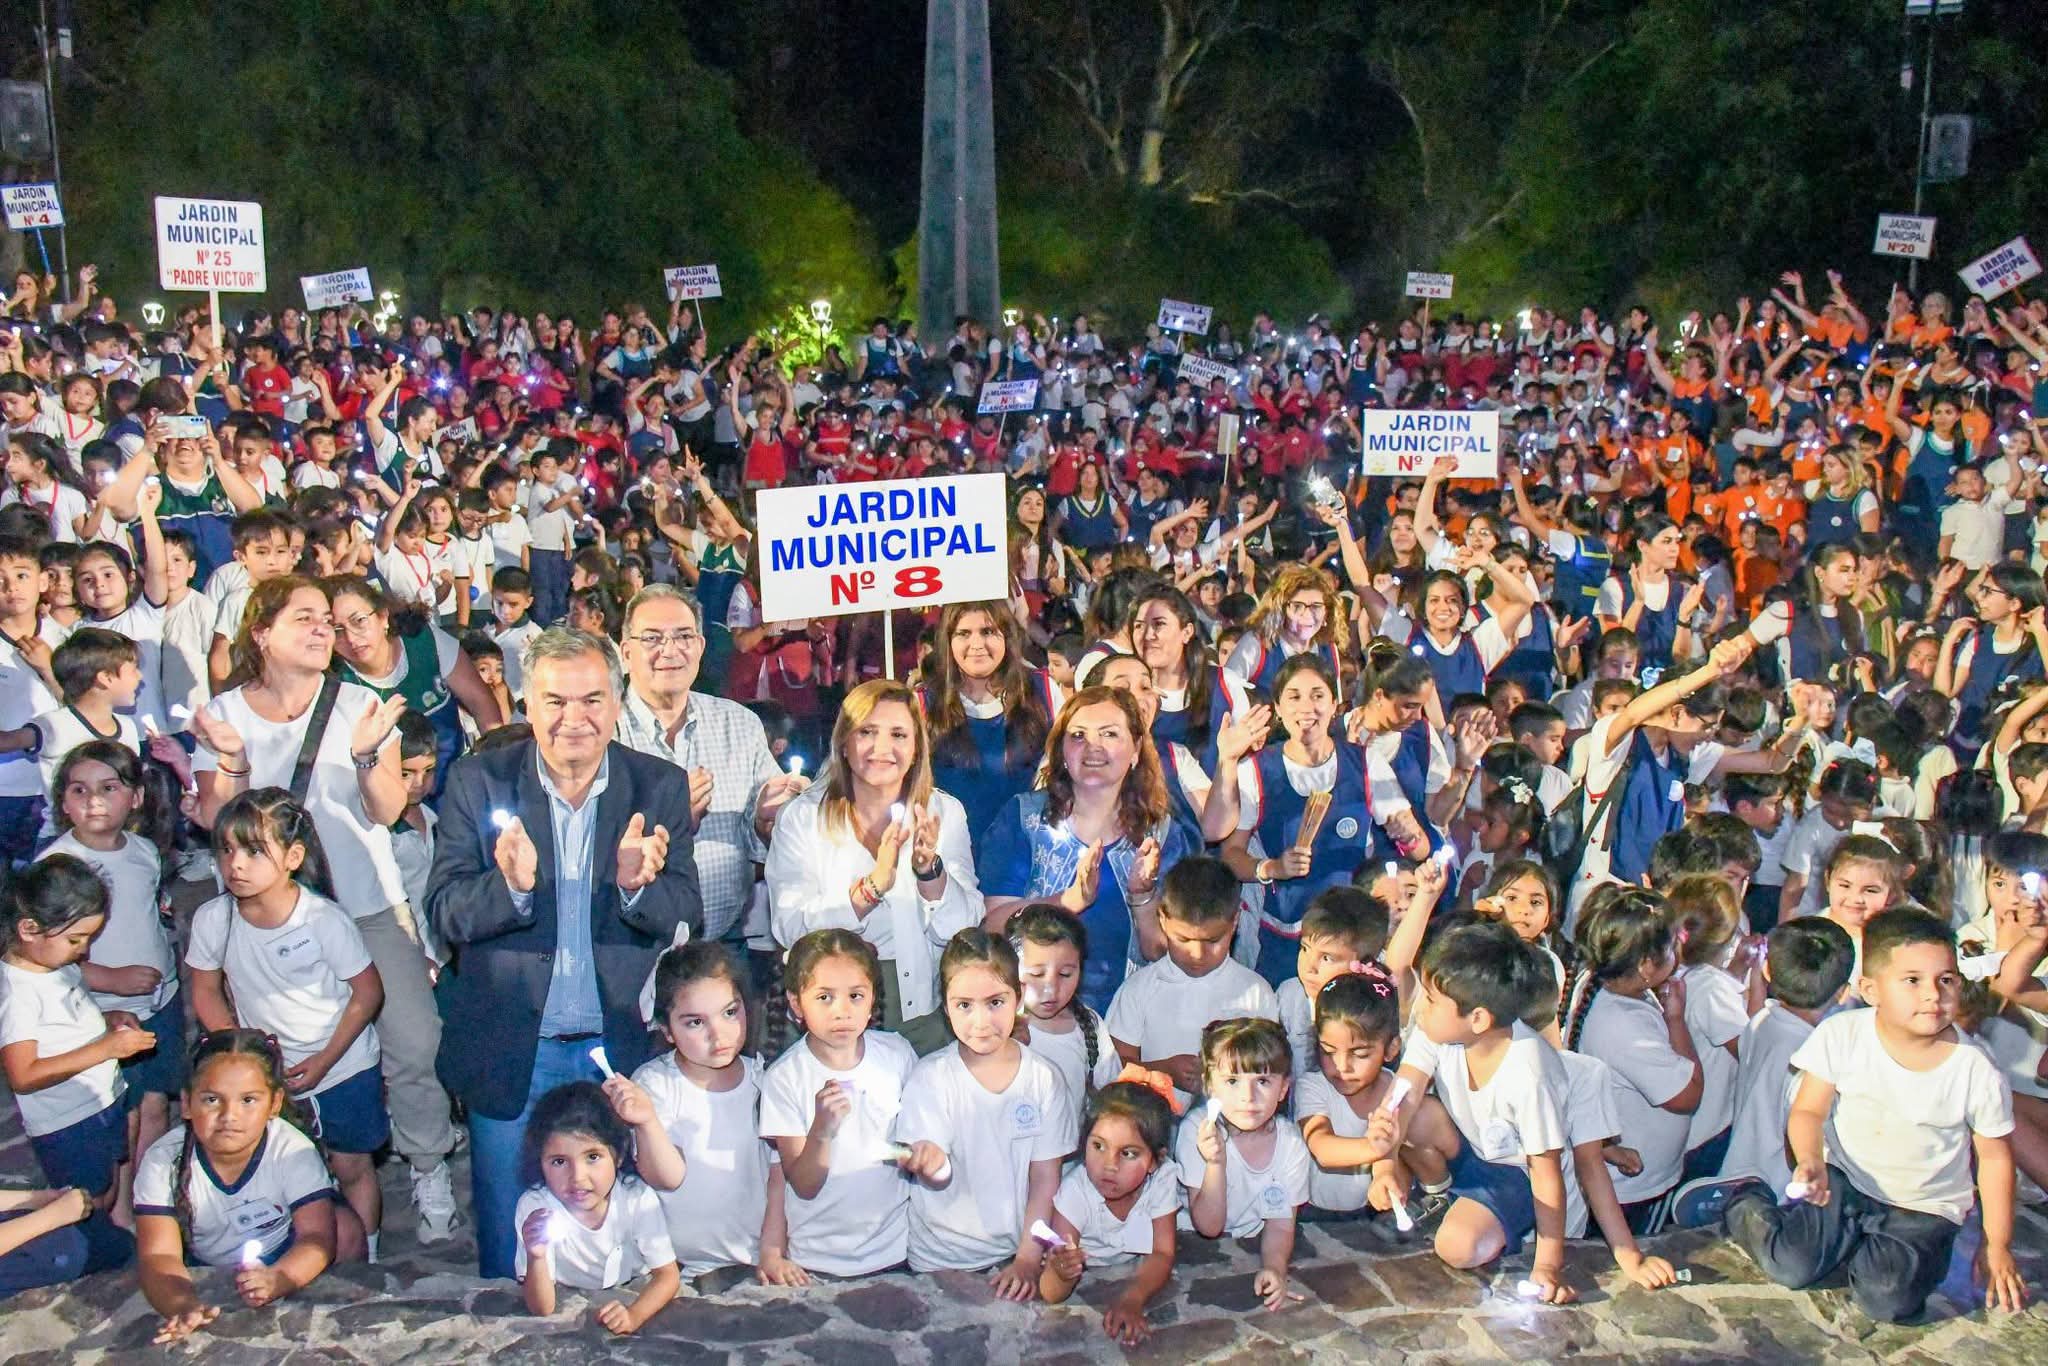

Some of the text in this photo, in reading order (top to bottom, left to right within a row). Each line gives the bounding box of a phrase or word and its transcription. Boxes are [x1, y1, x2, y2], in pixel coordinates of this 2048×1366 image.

[13, 187, 47, 200] JARDIN
[6, 200, 59, 214] MUNICIPAL
[178, 203, 238, 223] JARDIN
[39, 213, 50, 225] 4
[167, 224, 258, 246] MUNICIPAL
[214, 251, 232, 267] 25
[1976, 254, 2029, 288] MUNICIPAL
[2012, 271, 2022, 281] 3
[1389, 415, 1470, 432] JARDIN
[1369, 435, 1491, 452] MUNICIPAL
[1398, 455, 1423, 471] Nº
[807, 486, 956, 528] JARDIN
[772, 523, 996, 571] MUNICIPAL
[831, 566, 943, 605] Nº 8
